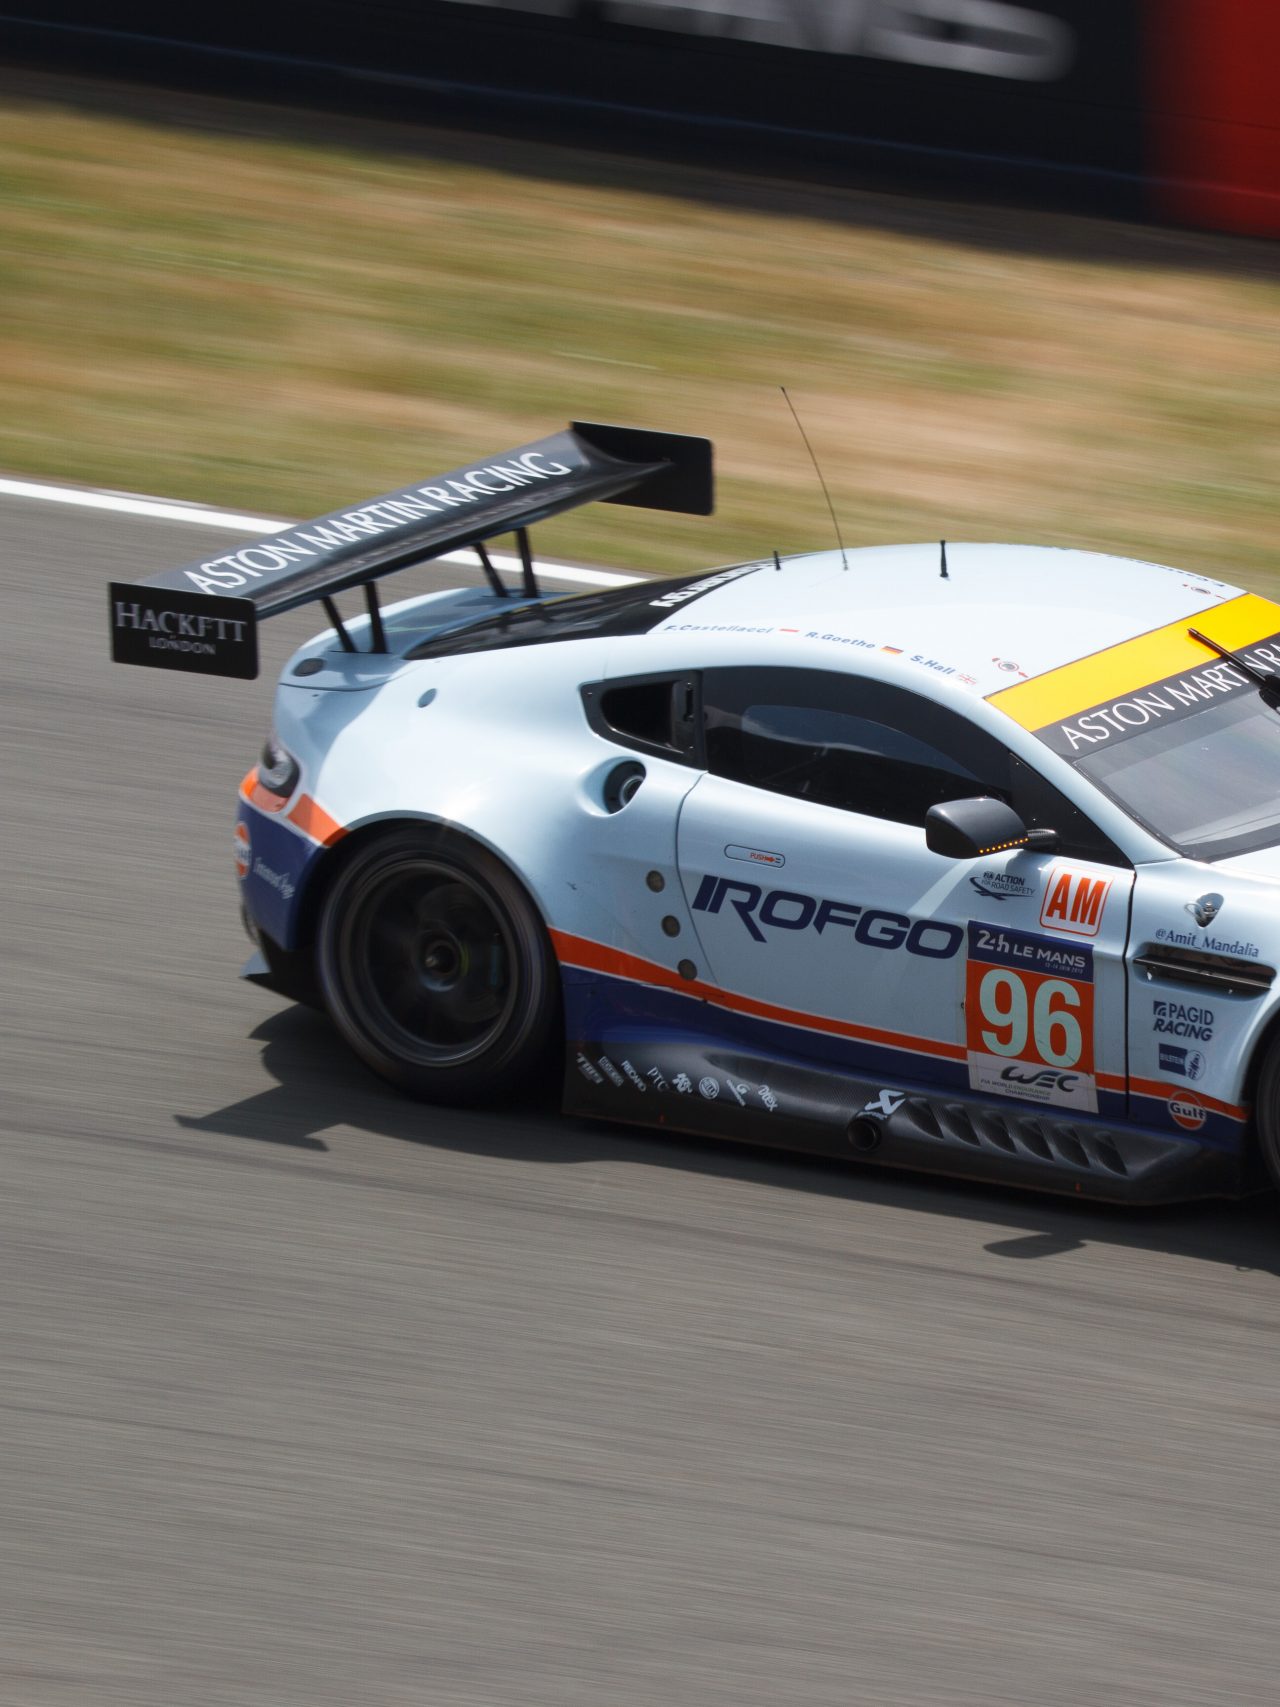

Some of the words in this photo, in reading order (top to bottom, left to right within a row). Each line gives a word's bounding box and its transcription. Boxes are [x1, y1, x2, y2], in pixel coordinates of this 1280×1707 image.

[184, 532, 318, 595] ASTON
[304, 494, 445, 550] MARTIN
[417, 453, 572, 507] RACING
[115, 601, 248, 642] HACKETT
[149, 636, 216, 656] LONDON
[1061, 692, 1175, 750] ASTON
[991, 881, 1009, 891] ROAD
[1010, 884, 1036, 896] SAFETY
[995, 873, 1025, 886] ACTION
[1045, 873, 1107, 926] AM
[977, 930, 1009, 953] 24h
[1013, 943, 1033, 958] LE
[1036, 949, 1086, 968] MANS
[1155, 928, 1259, 957] @Amit_Mandalia
[979, 968, 1082, 1068] 96
[1169, 1002, 1214, 1026] PAGID
[1152, 1018, 1213, 1042] RACING
[1001, 1066, 1079, 1092] WEC
[1170, 1102, 1206, 1119] Gulf
